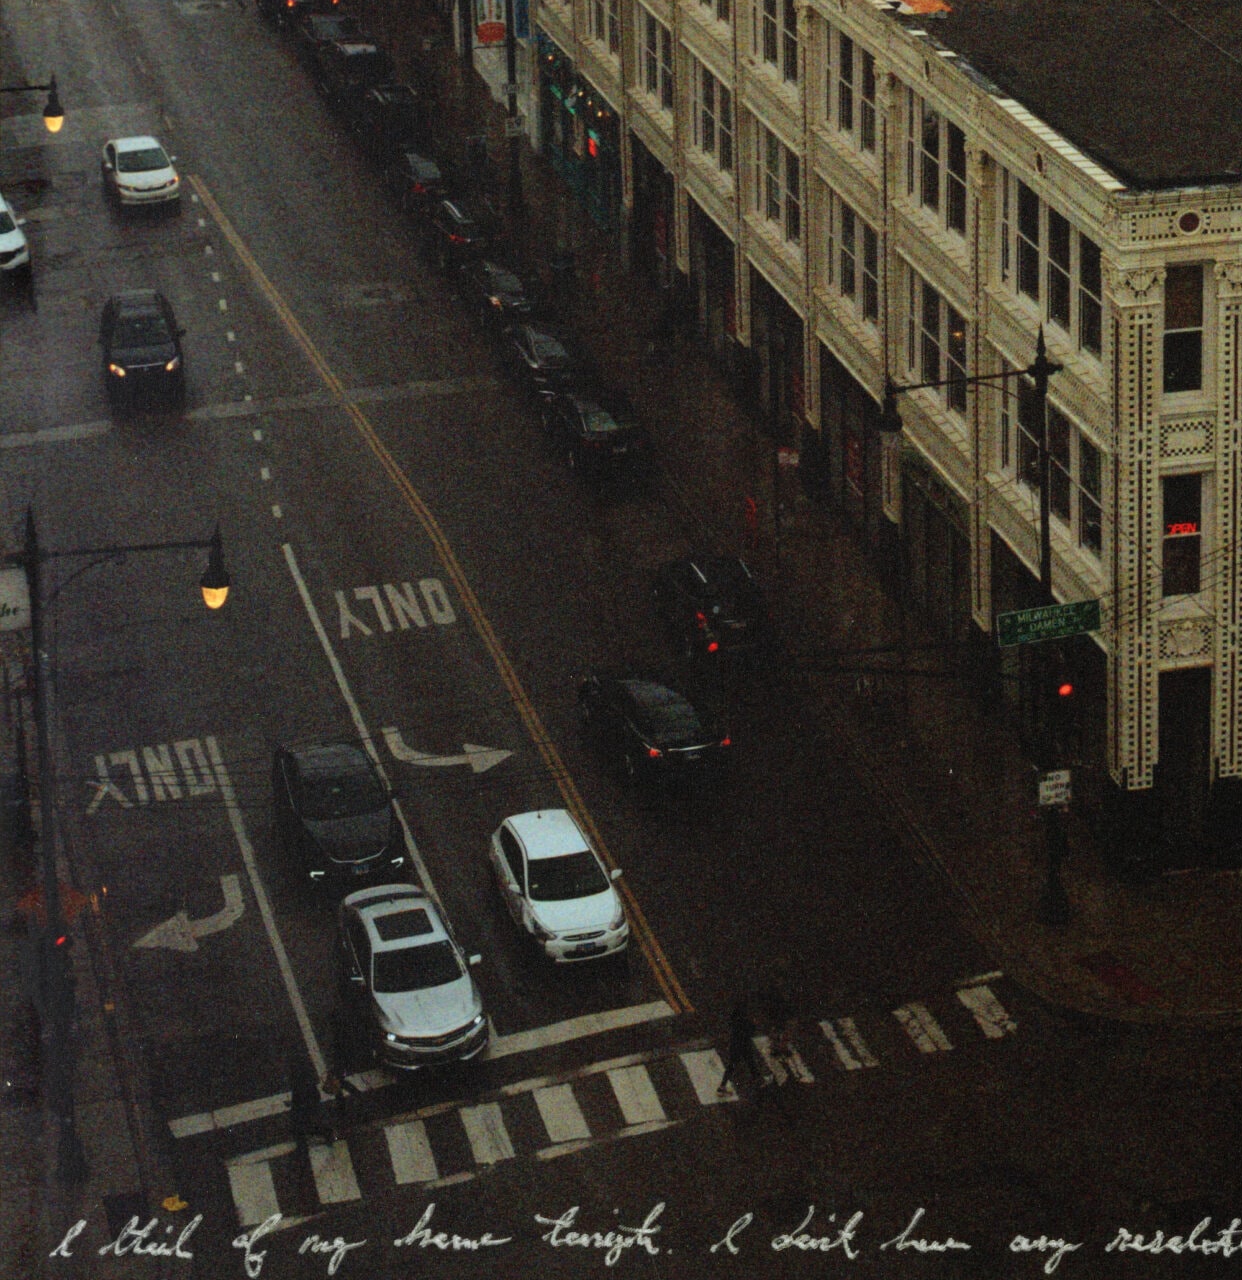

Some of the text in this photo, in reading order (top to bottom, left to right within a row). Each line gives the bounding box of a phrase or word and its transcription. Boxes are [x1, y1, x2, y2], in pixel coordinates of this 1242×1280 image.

[335, 577, 457, 640] ONLY
[1029, 617, 1066, 632] DAMEN
[86, 736, 220, 816] ONLY
